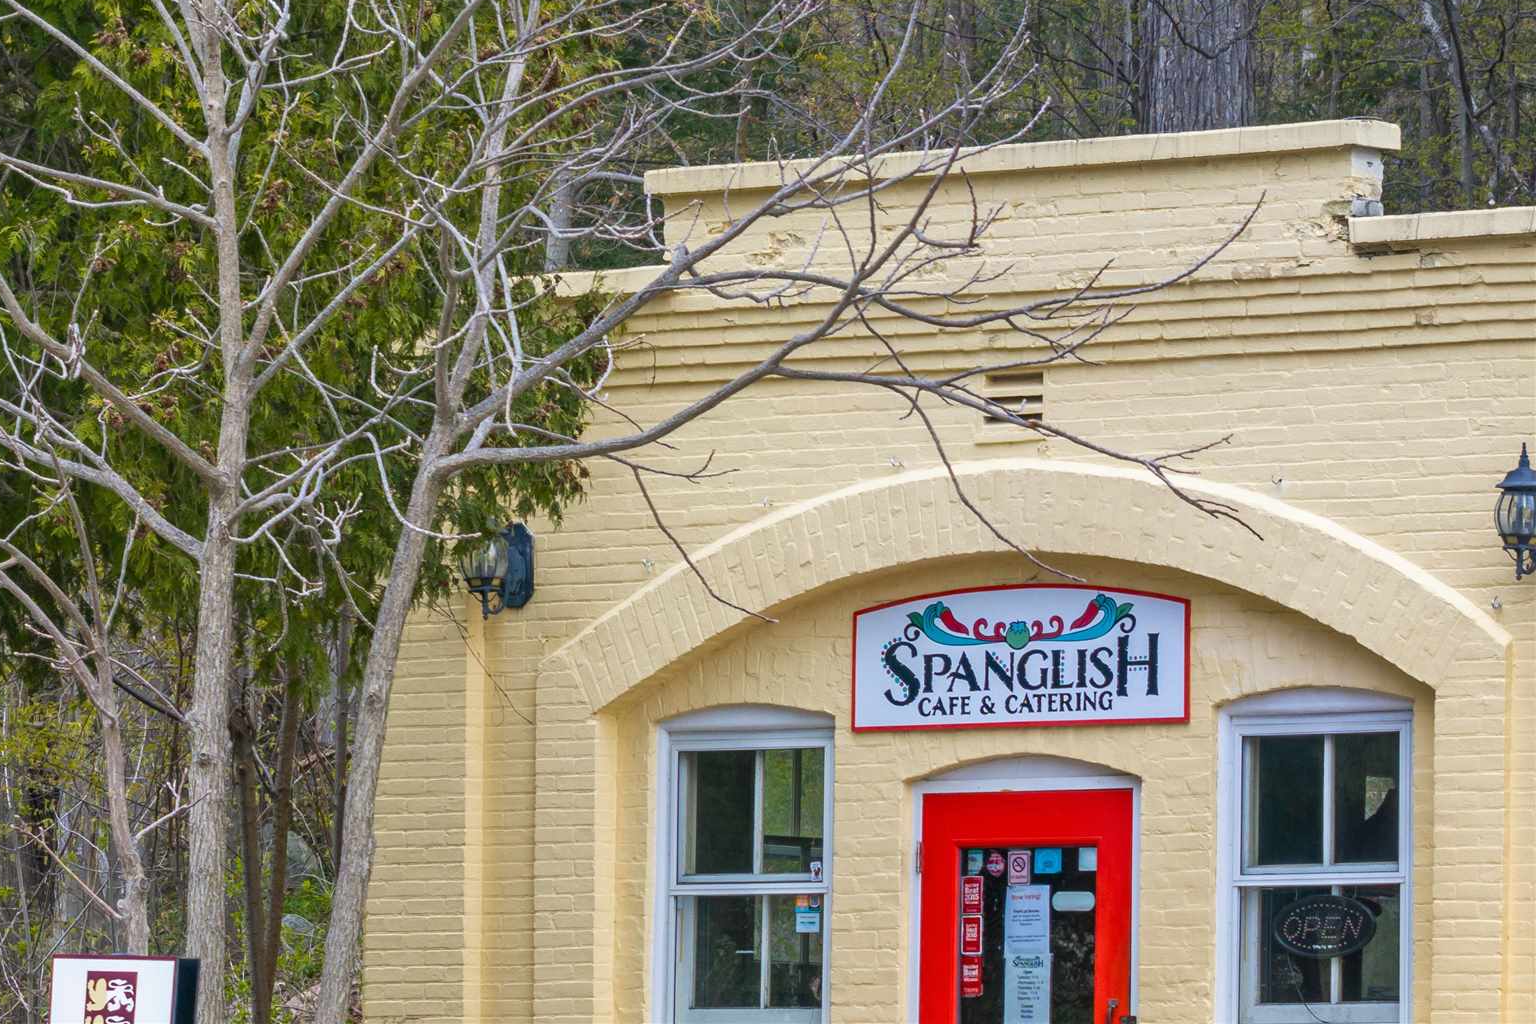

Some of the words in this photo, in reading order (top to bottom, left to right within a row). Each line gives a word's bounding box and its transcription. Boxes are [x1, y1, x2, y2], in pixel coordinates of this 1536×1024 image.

[880, 632, 1160, 707] SPANGLISH
[918, 695, 971, 717] CAFE
[980, 695, 997, 714] &
[1005, 690, 1114, 714] CATERING
[1283, 915, 1364, 939] OPEN
